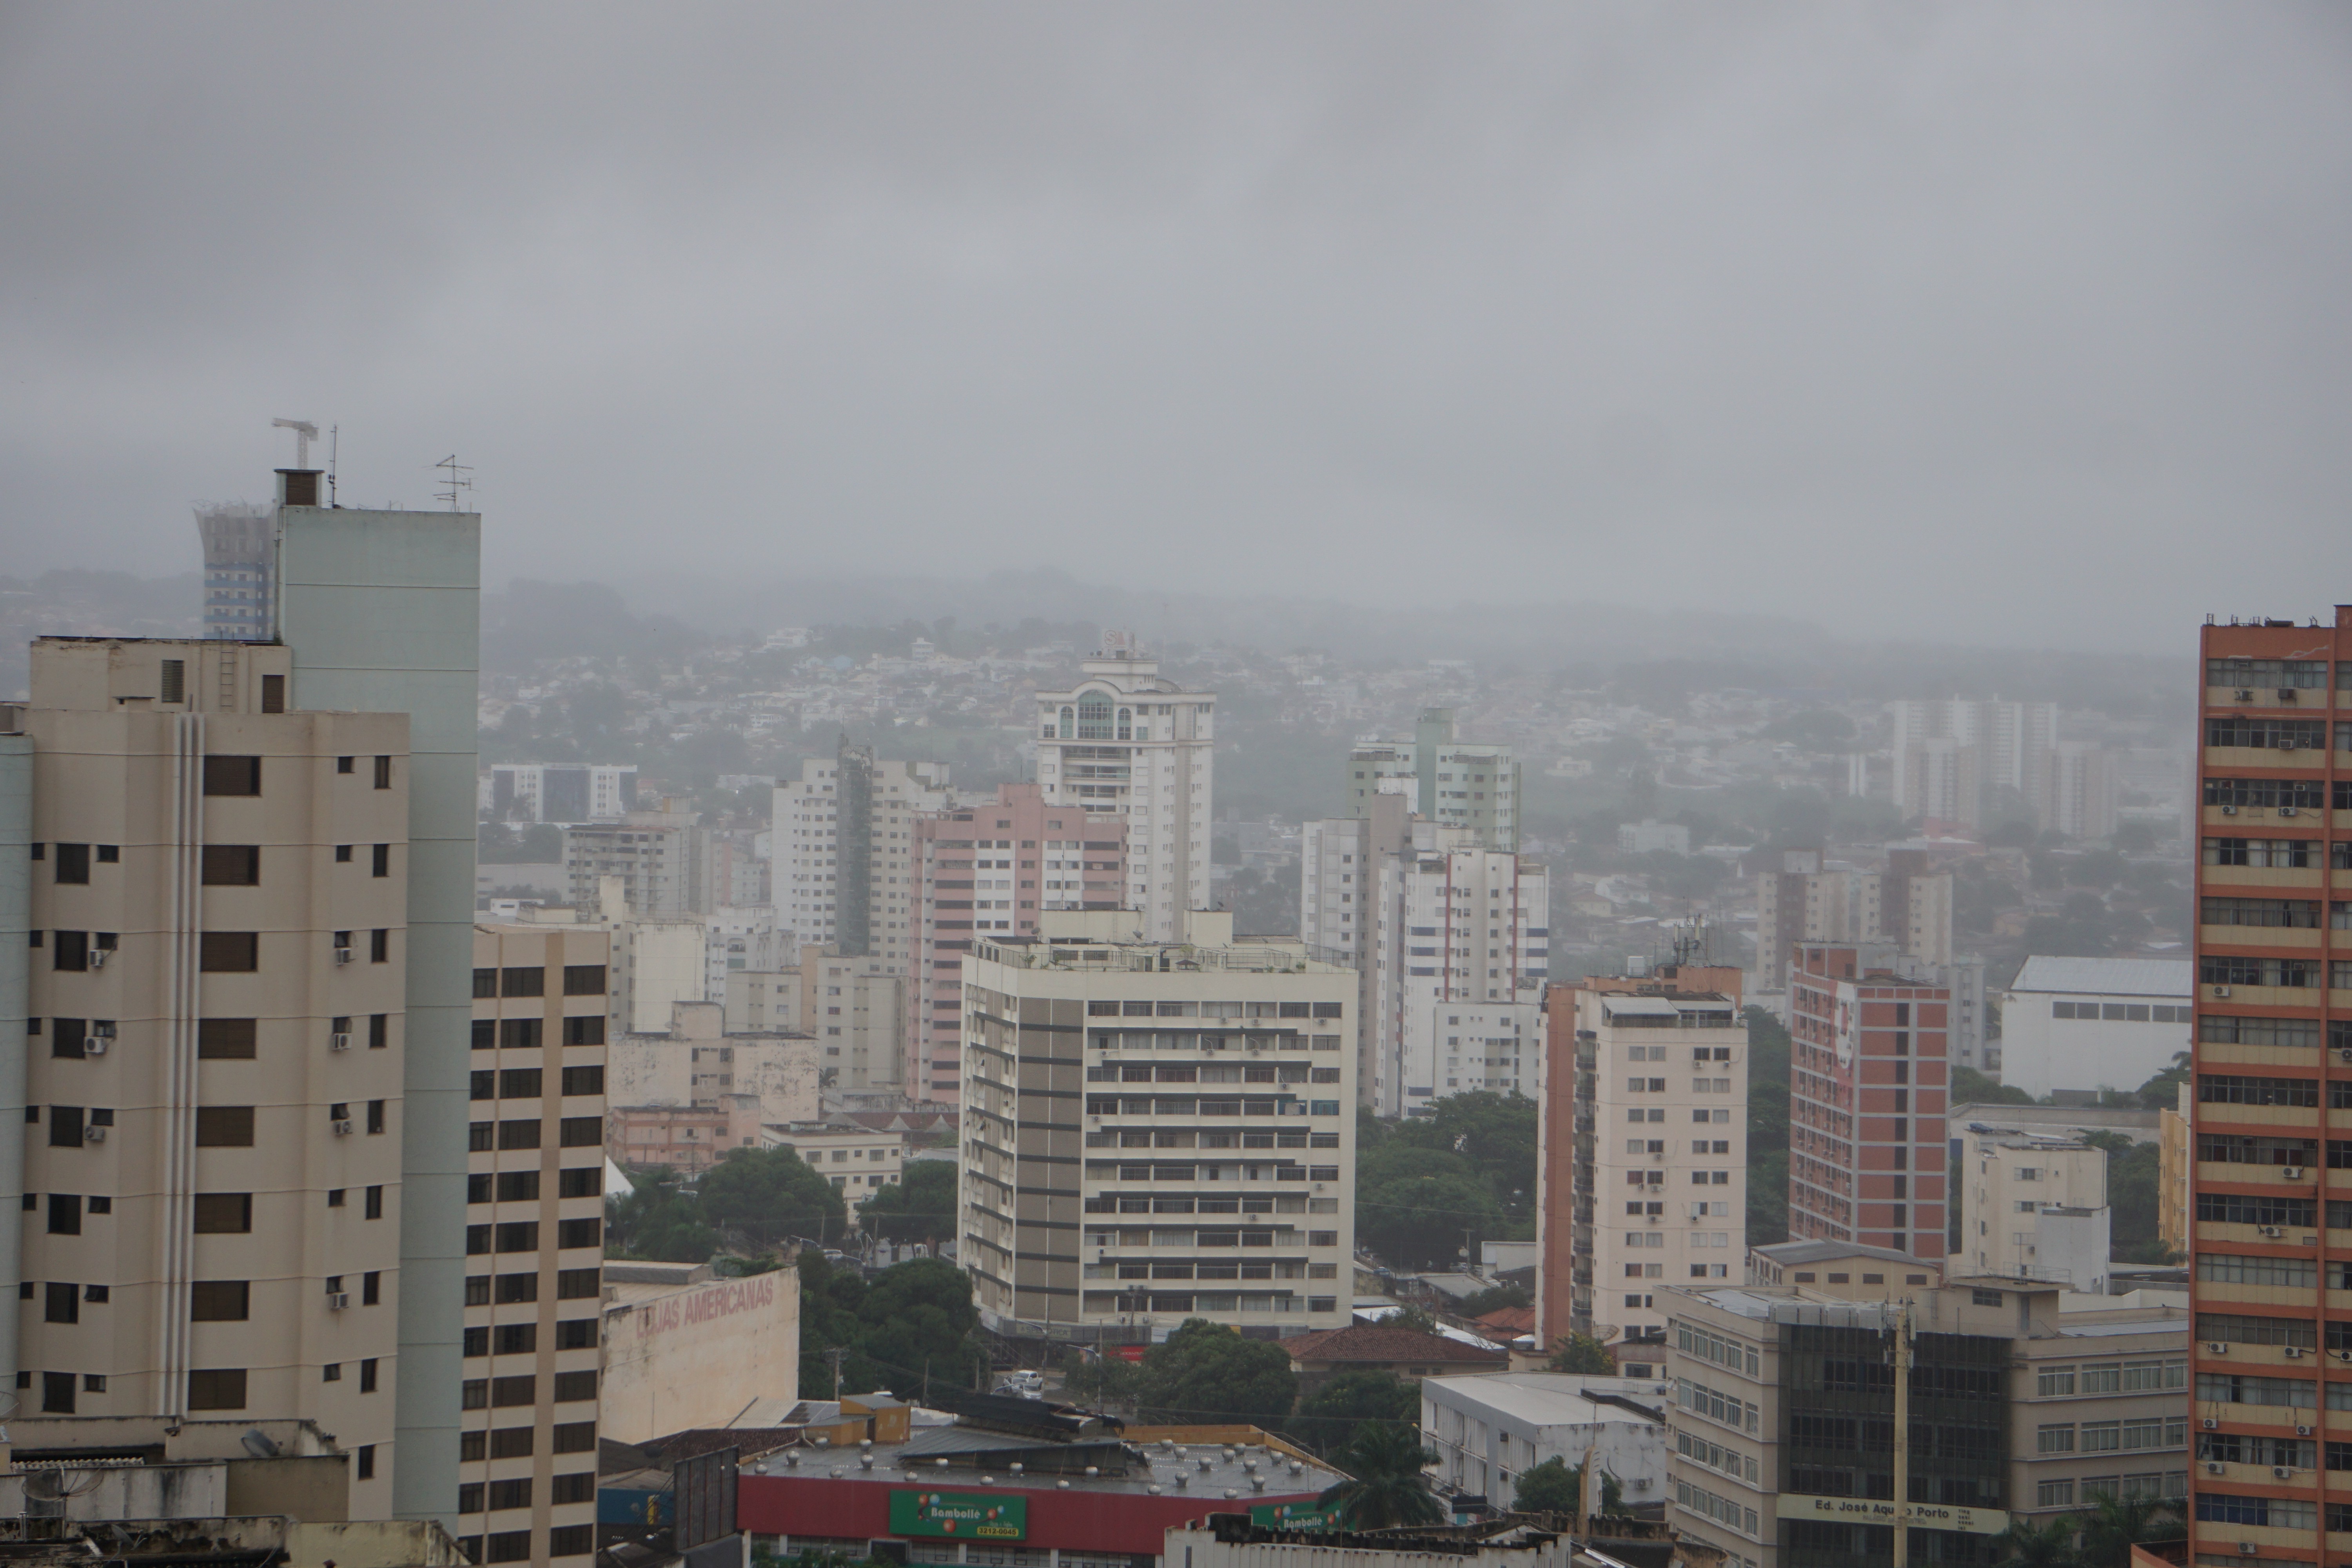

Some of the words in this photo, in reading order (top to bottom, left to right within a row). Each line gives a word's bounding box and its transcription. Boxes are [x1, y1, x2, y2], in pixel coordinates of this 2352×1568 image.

[637, 1299, 680, 1339] LOJAS
[684, 1277, 773, 1326] AMERICANAS
[1815, 1499, 1834, 1510] Ed.
[1839, 1501, 1868, 1512] José
[1873, 1503, 1912, 1515] Aquo
[1917, 1506, 1949, 1518] Porto
[979, 1527, 1016, 1535] 3212-0045
